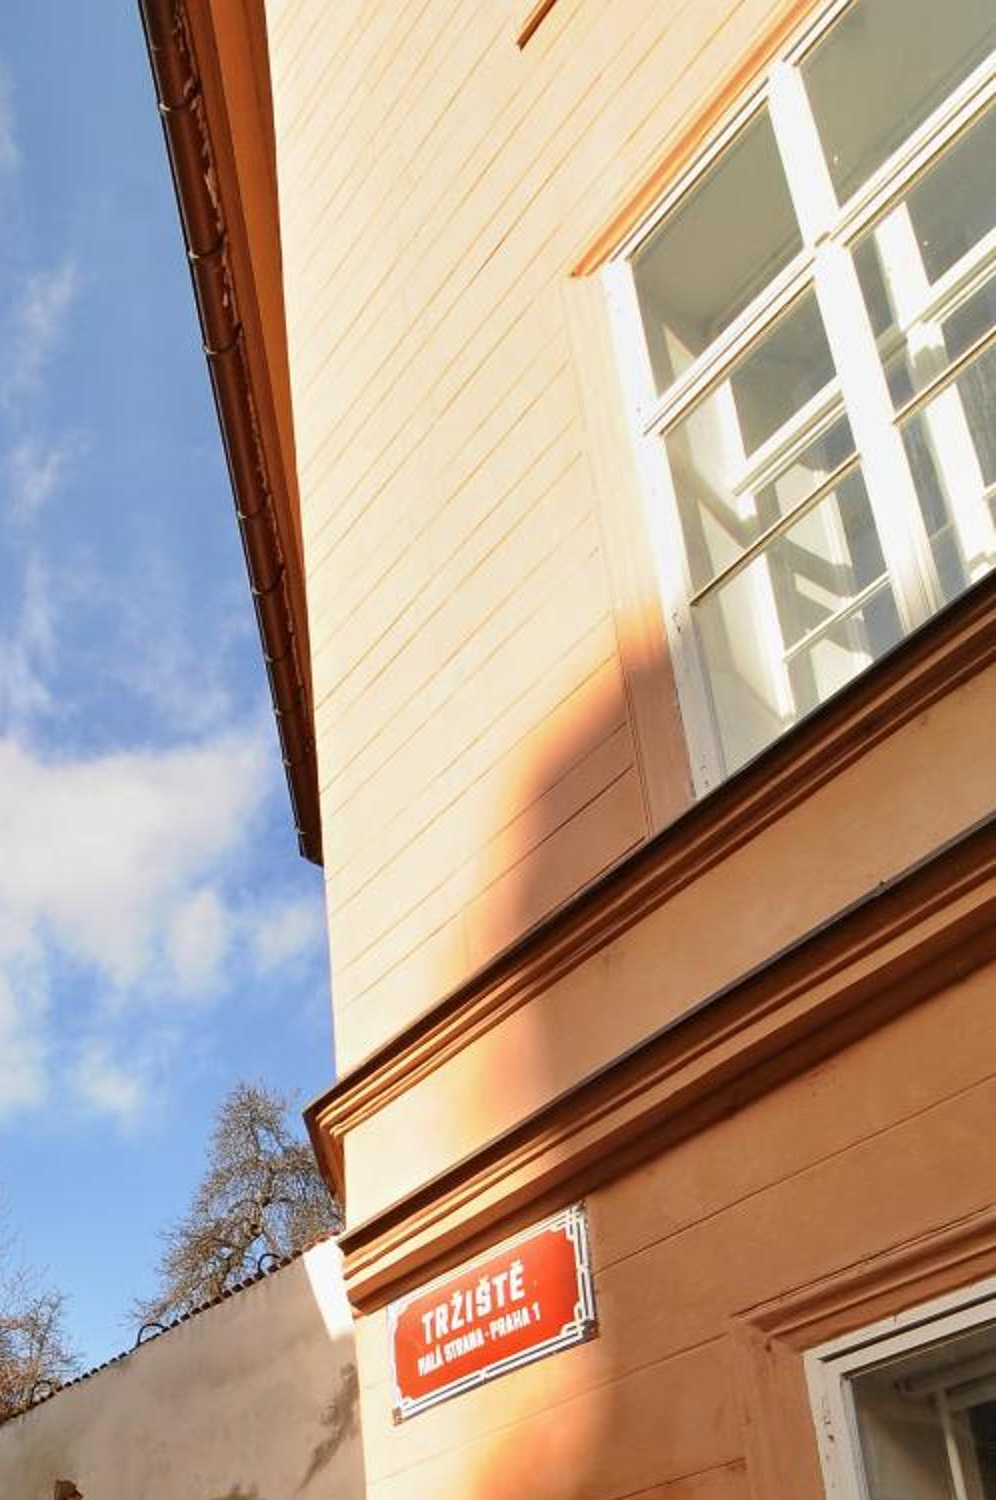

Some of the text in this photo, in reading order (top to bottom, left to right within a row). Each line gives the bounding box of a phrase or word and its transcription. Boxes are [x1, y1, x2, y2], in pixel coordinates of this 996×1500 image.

[417, 1344, 444, 1376] MALÁ
[489, 1309, 531, 1340] PRAHA
[532, 1302, 541, 1321] 1
[422, 1258, 525, 1344] TRŽIŠTĚ
